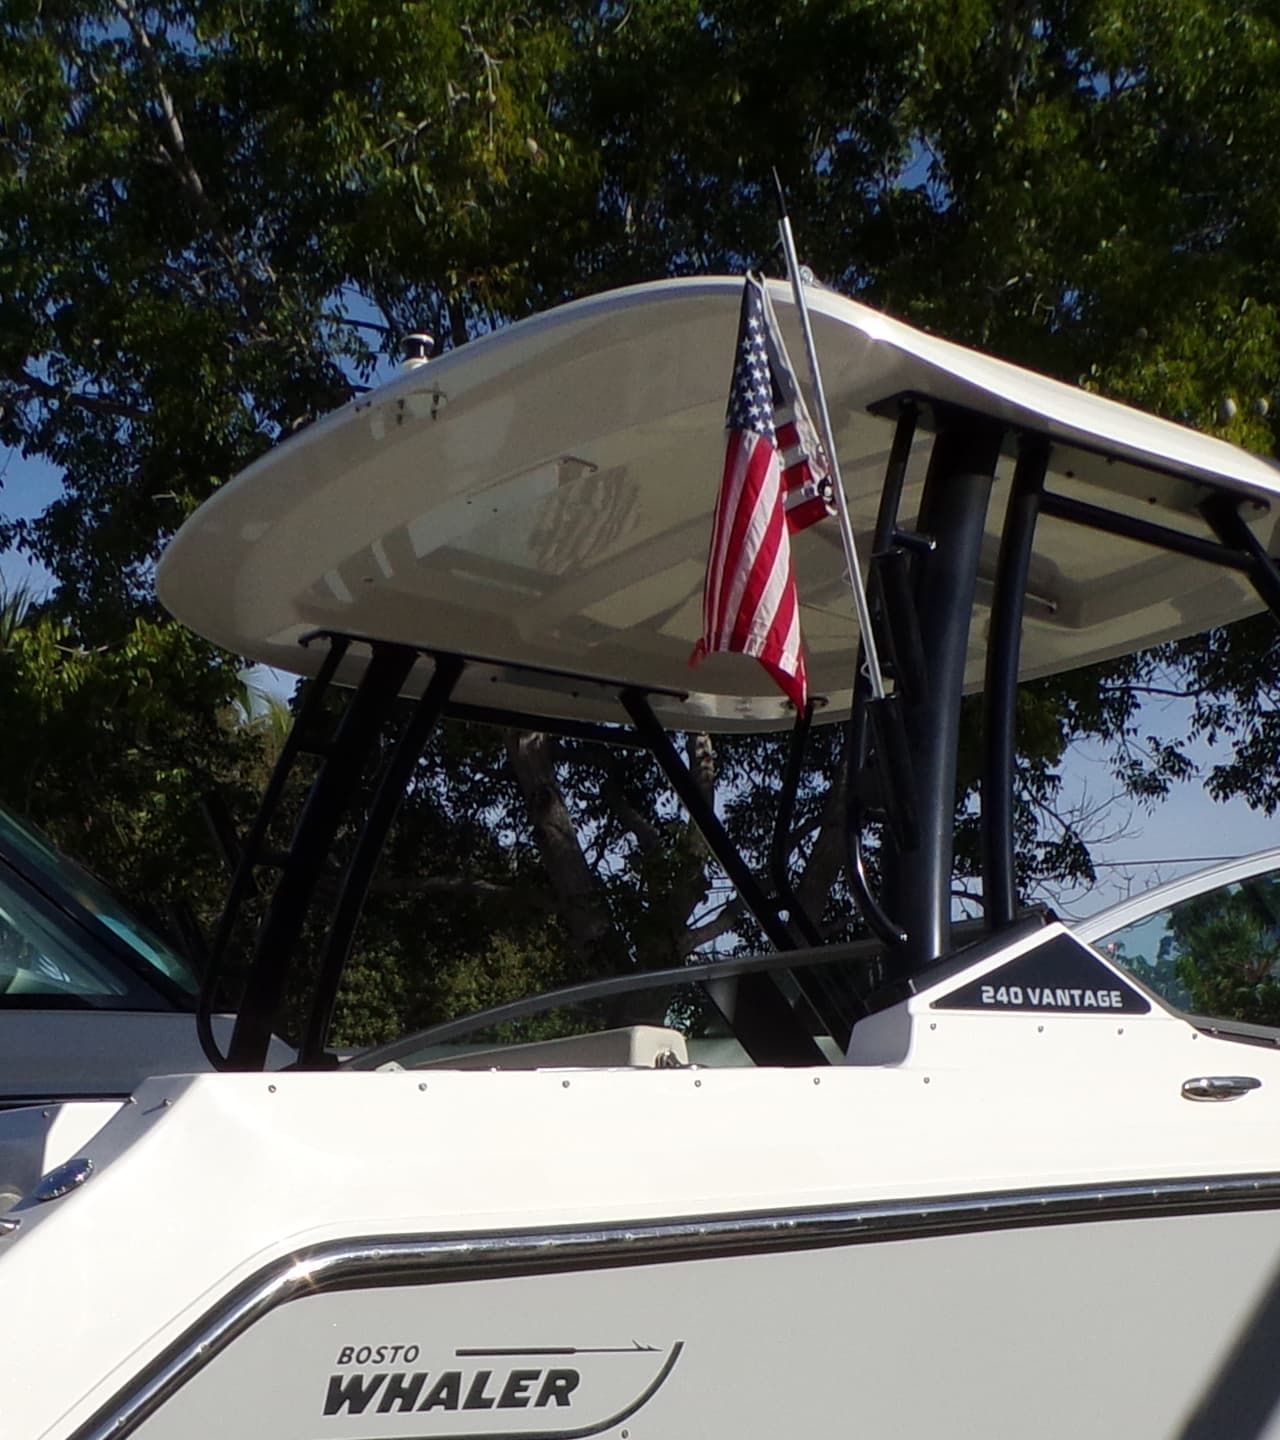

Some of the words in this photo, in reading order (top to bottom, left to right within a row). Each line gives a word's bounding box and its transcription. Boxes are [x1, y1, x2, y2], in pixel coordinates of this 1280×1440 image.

[980, 986, 1023, 1005] 240
[1025, 987, 1123, 1008] VANTAGE
[336, 1344, 420, 1366] BOSTO
[321, 1368, 581, 1416] WHALER
